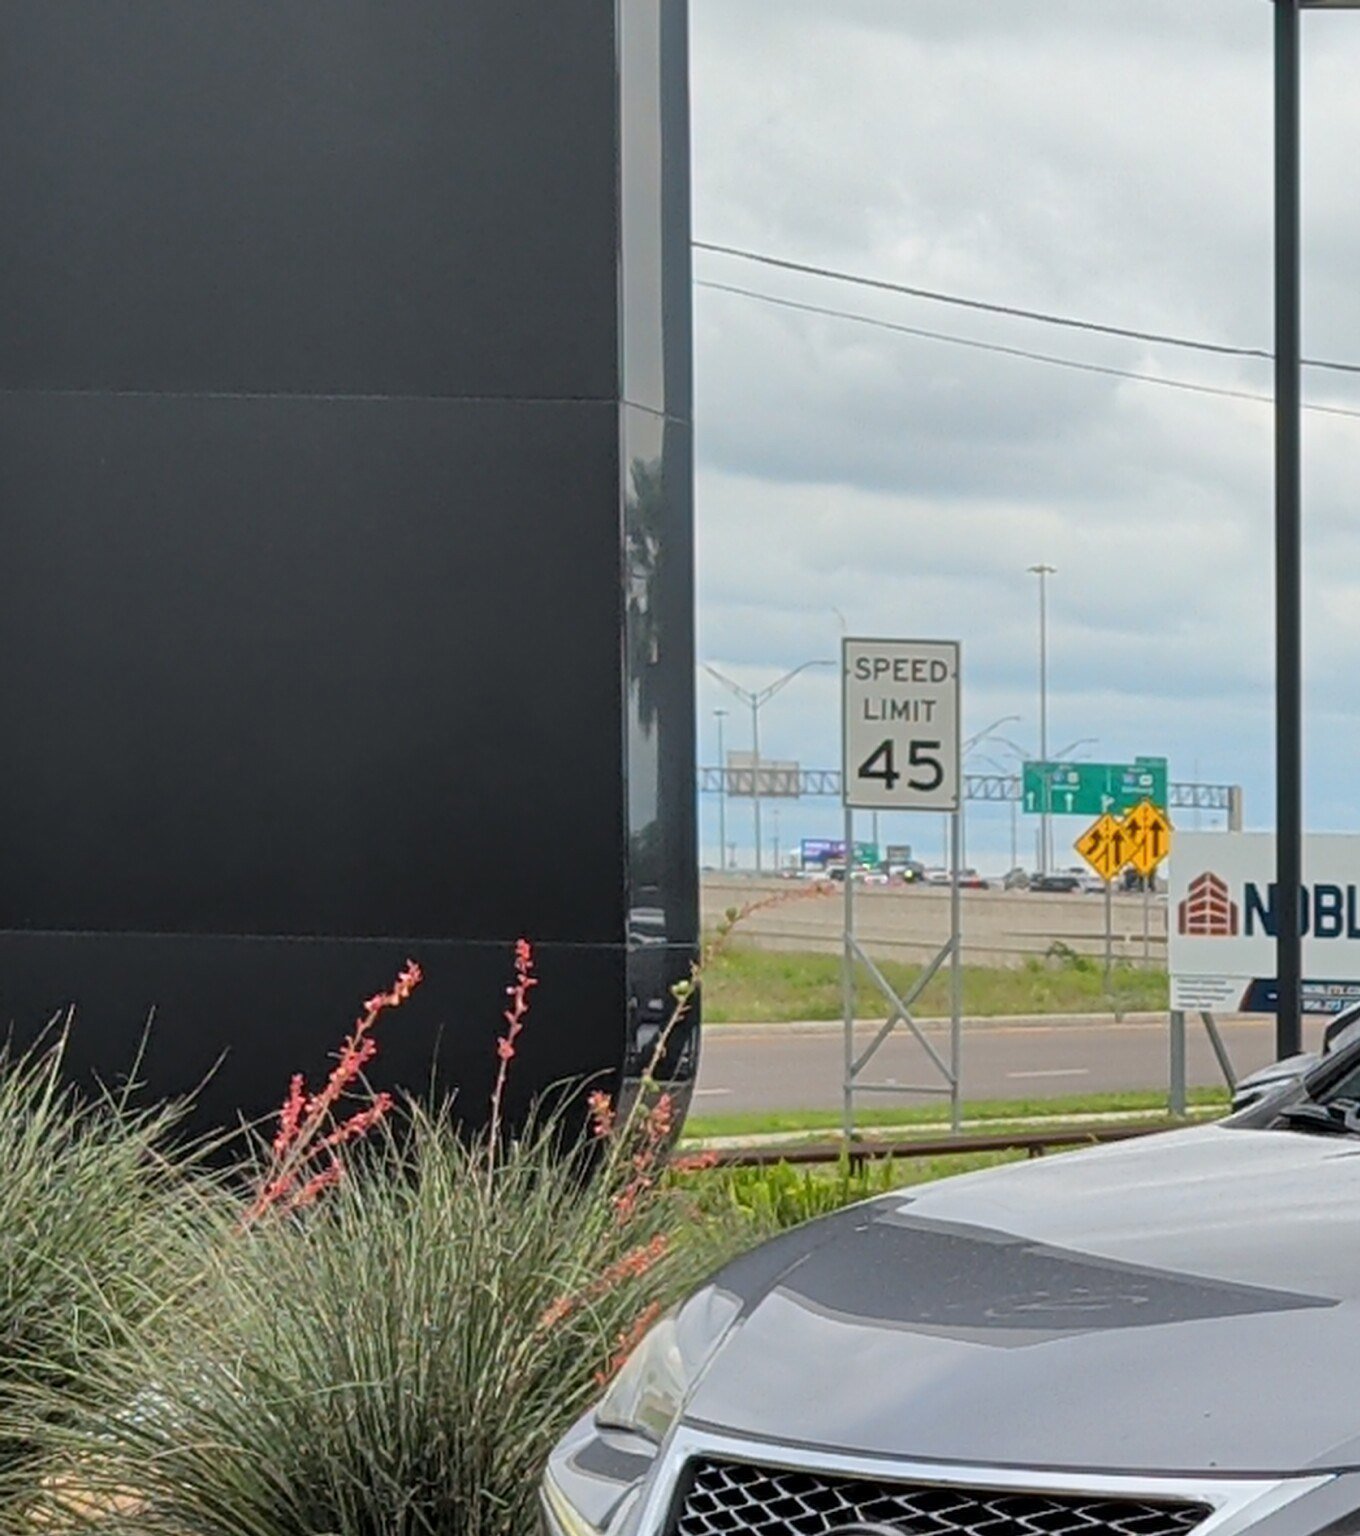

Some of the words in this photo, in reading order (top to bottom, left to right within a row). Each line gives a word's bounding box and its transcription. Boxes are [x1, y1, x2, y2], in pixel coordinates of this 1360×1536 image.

[854, 656, 948, 683] SPEED
[863, 697, 937, 722] LIMIT
[857, 738, 944, 792] 45
